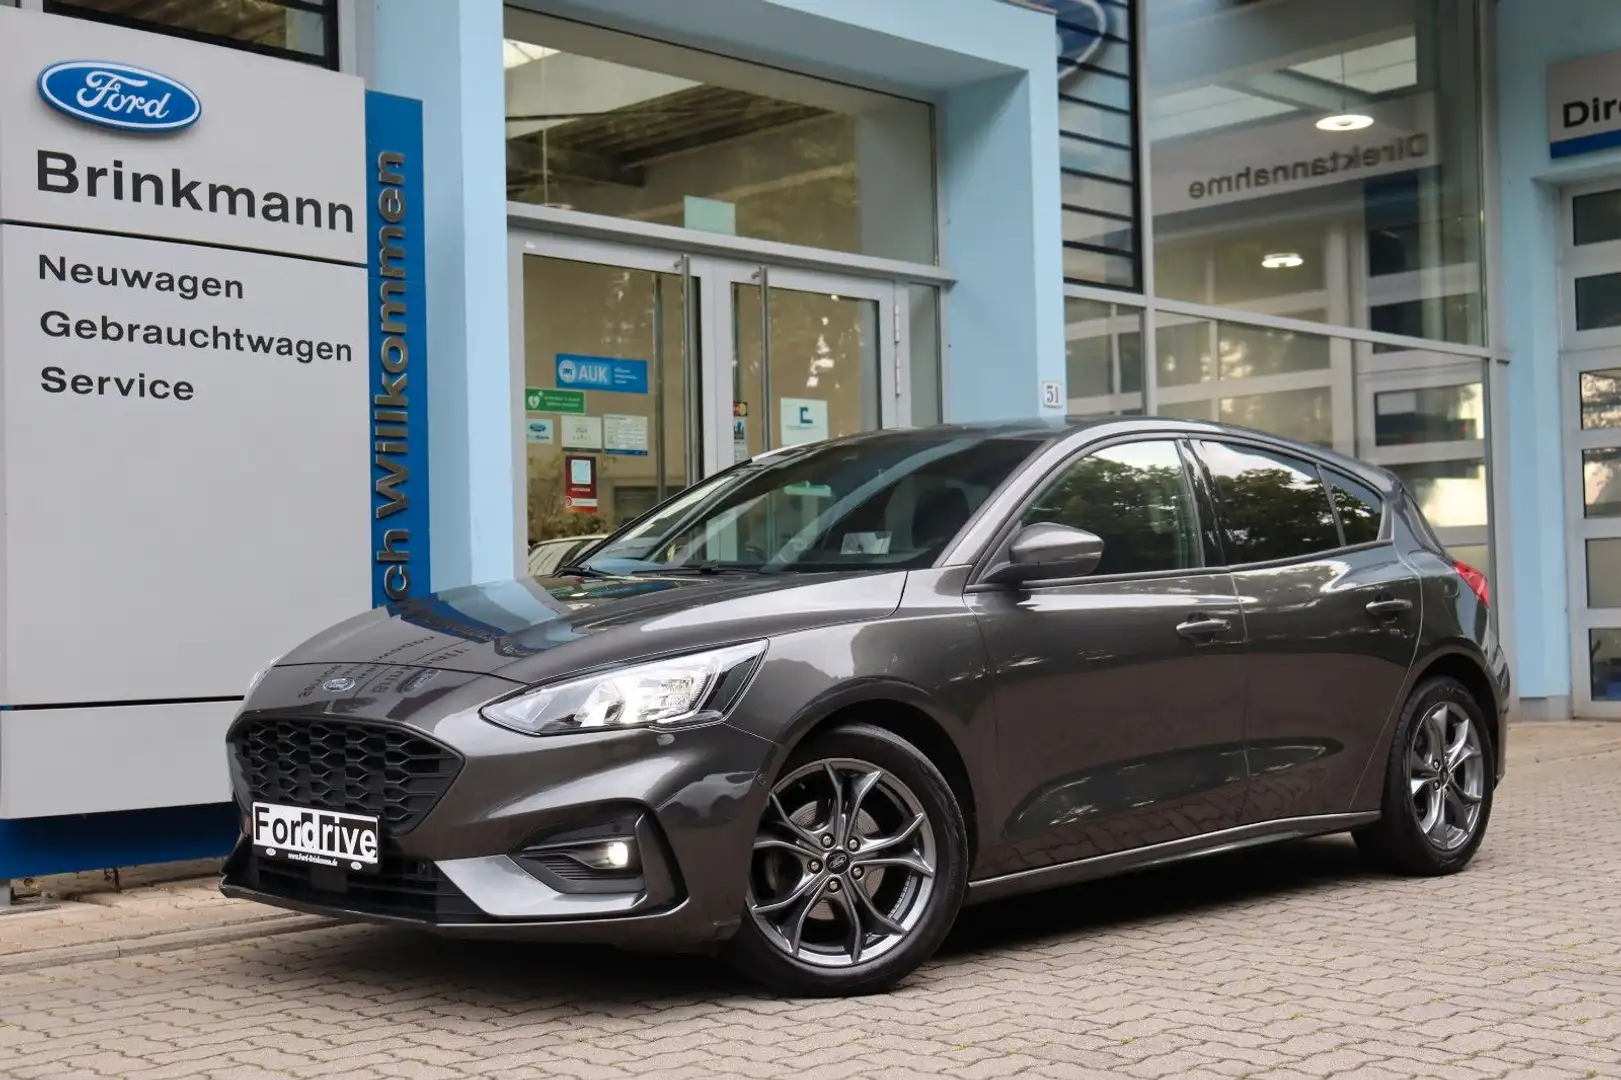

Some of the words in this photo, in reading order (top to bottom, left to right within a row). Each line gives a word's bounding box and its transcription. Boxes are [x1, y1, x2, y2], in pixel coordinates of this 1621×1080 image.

[76, 70, 170, 119] Ford
[1563, 96, 1621, 128] Dir
[37, 150, 353, 233] Brinkmann
[39, 254, 244, 300] Neuwagen
[40, 311, 352, 364] Gebrauchtwagen
[374, 151, 409, 519] Willkommen
[41, 366, 194, 401] Service
[579, 364, 608, 384] AUK
[1046, 385, 1059, 403] 51
[376, 528, 409, 603] ch
[255, 806, 377, 860] Fordrive
